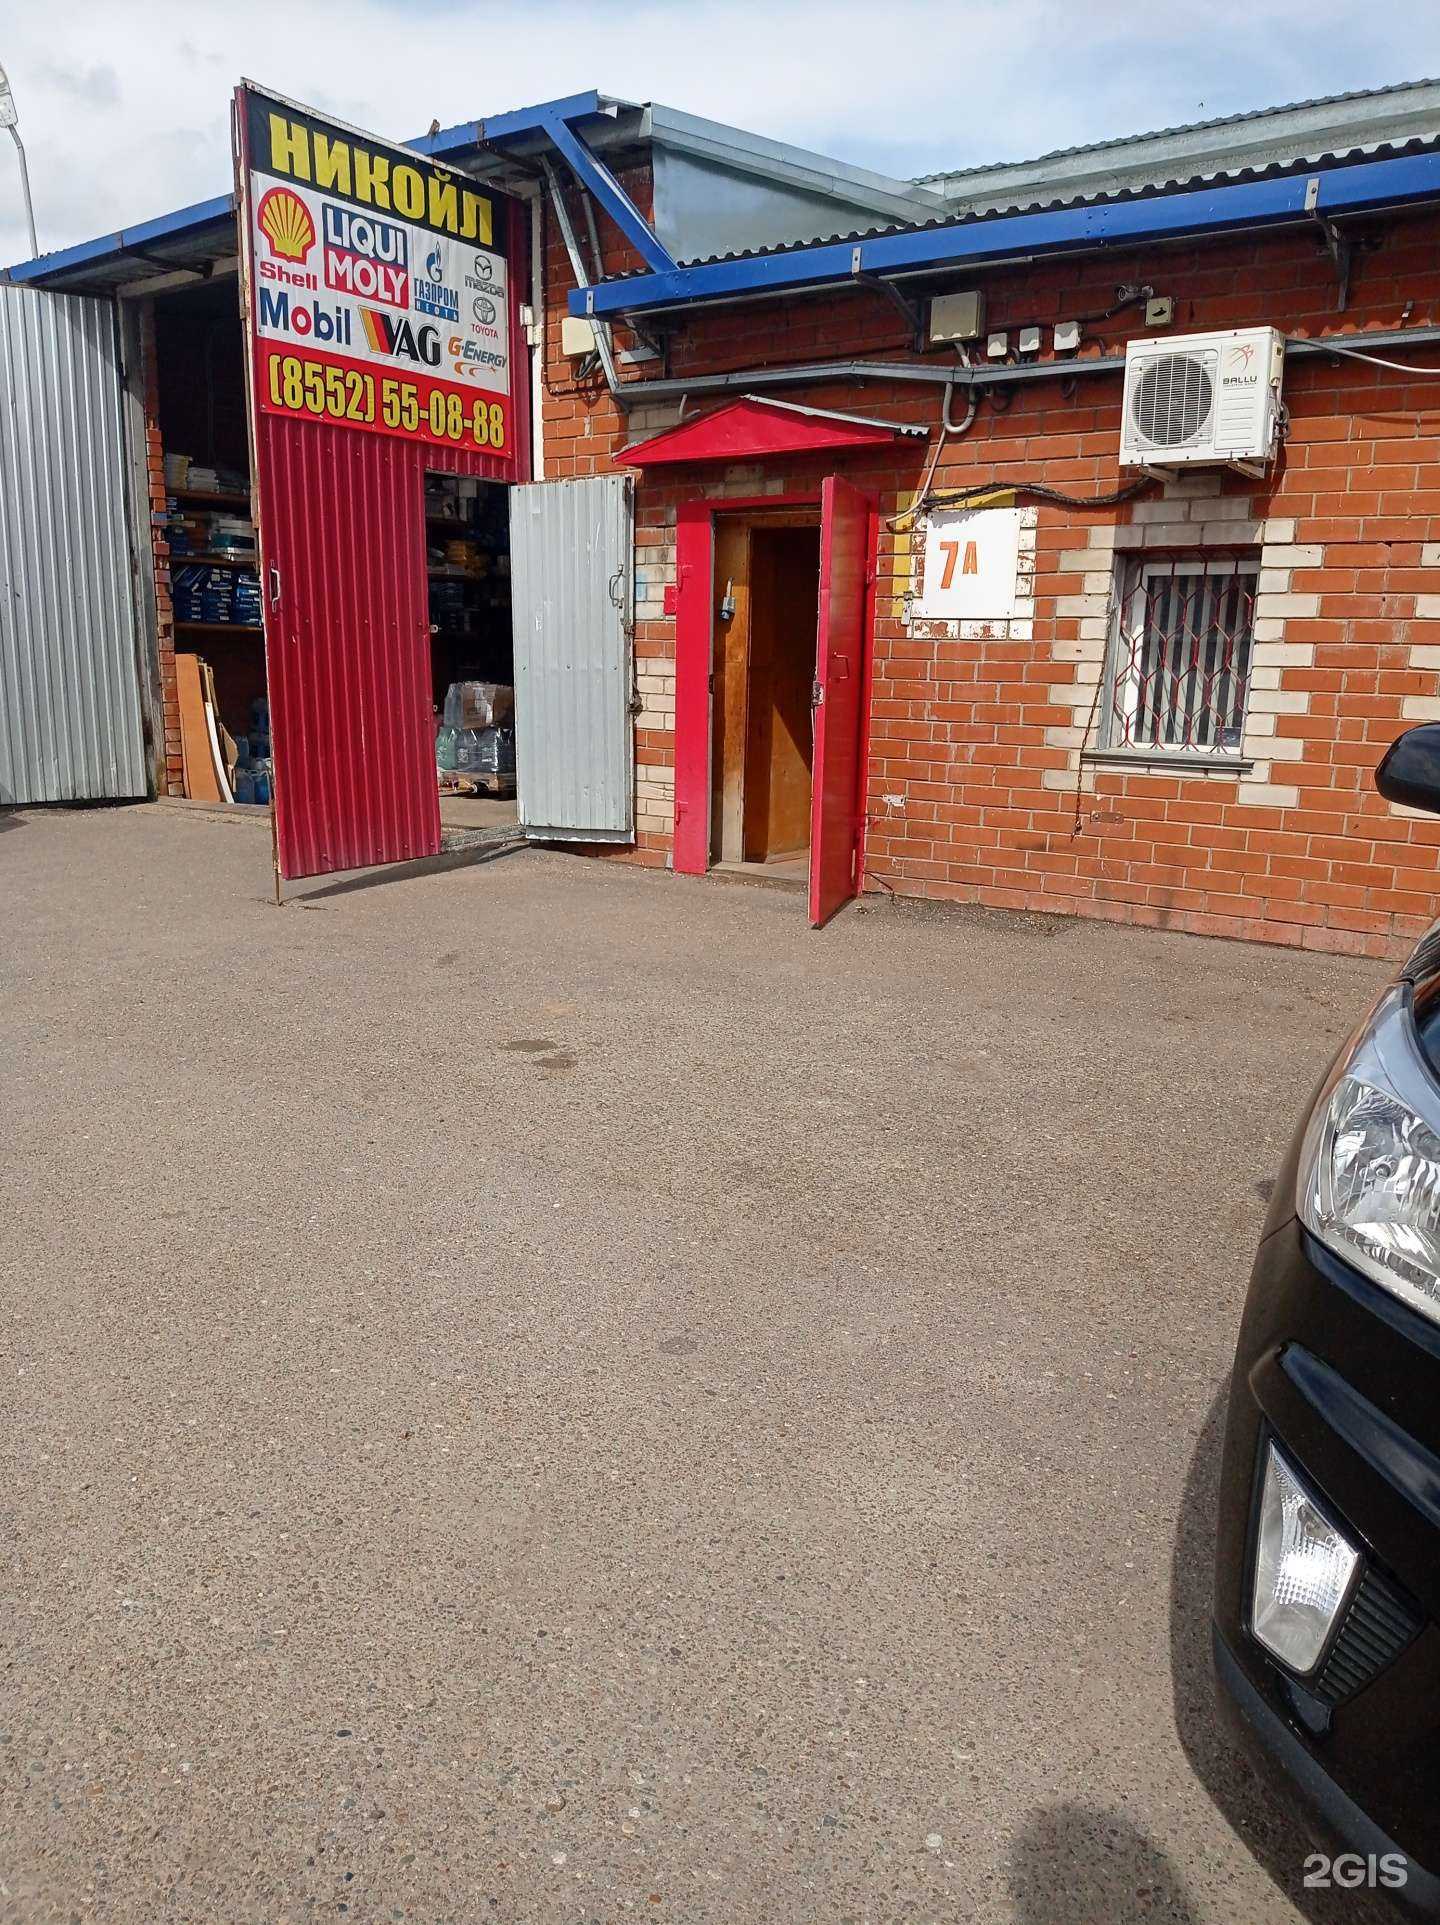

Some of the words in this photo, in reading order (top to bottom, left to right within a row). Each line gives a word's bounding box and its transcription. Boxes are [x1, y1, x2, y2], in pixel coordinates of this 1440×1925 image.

[269, 112, 493, 246] НИКОЙЛ
[326, 207, 404, 266] LIQUI
[260, 261, 318, 291] Shell
[329, 251, 407, 305] MOLY
[414, 277, 459, 309] ГАЗПРОМ
[259, 287, 351, 345] Mobil
[359, 306, 441, 367] VAG
[472, 323, 498, 339] TOYOTA
[269, 354, 375, 424] (8552)
[382, 378, 505, 448] 55-08-88
[1223, 376, 1257, 384] BALLU
